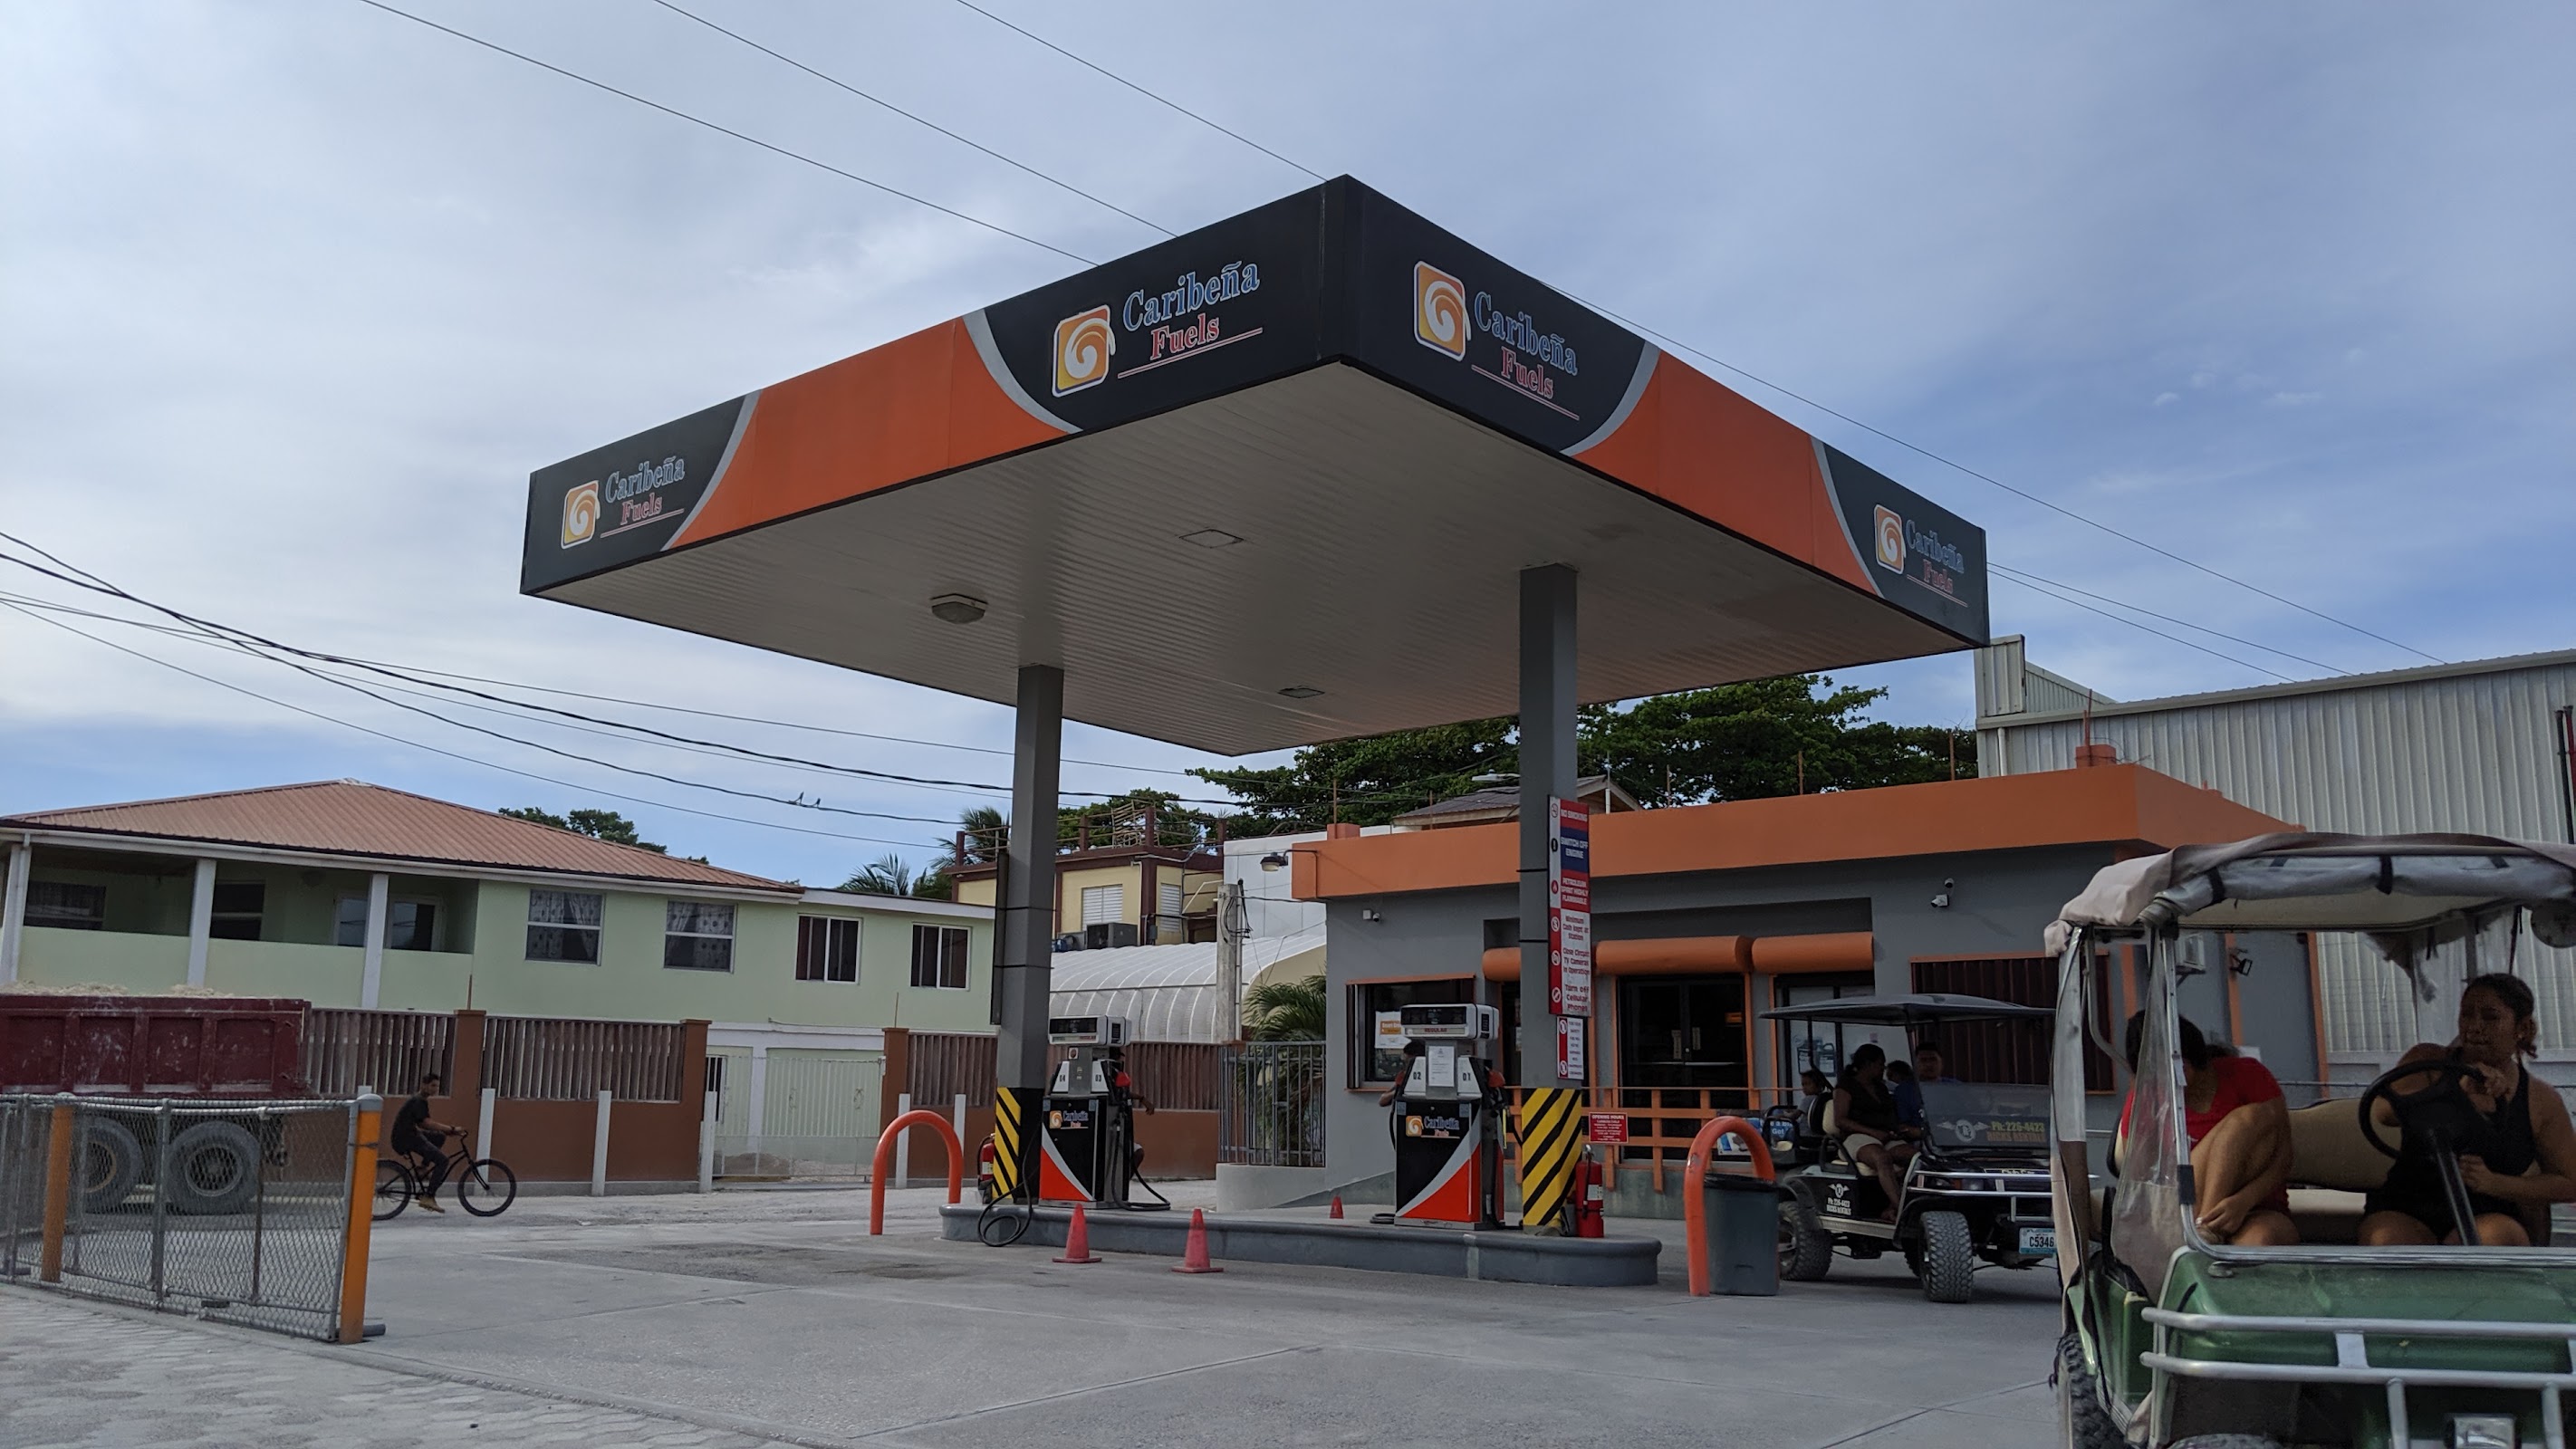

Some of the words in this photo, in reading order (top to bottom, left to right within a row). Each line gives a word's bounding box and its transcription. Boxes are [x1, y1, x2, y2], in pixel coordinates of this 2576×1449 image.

[1122, 261, 1260, 331] Caribeña
[1149, 312, 1220, 361] Fuels
[1474, 291, 1578, 376] Caribeña
[1500, 346, 1553, 399] Fuels
[605, 456, 686, 504] Caribeña
[620, 492, 663, 526] Fuels
[1906, 519, 1965, 574] Caribeña
[1922, 558, 1954, 594] Fuels
[1561, 837, 1579, 847] SWITCH
[1579, 840, 1589, 849] OFF
[1566, 849, 1583, 859] ENGINE
[1562, 923, 1572, 931] Cash
[1562, 947, 1573, 955] Close
[1571, 957, 1589, 966] Cameras
[1564, 984, 1578, 993] Turn
[1579, 985, 1589, 993] off
[1566, 993, 1588, 1003] Cellular
[1059, 1074, 1066, 1082] 04
[1095, 1074, 1102, 1082] 03
[1413, 1071, 1421, 1080] 02
[1463, 1072, 1471, 1080] 01
[2029, 1236, 2054, 1247] C5346
